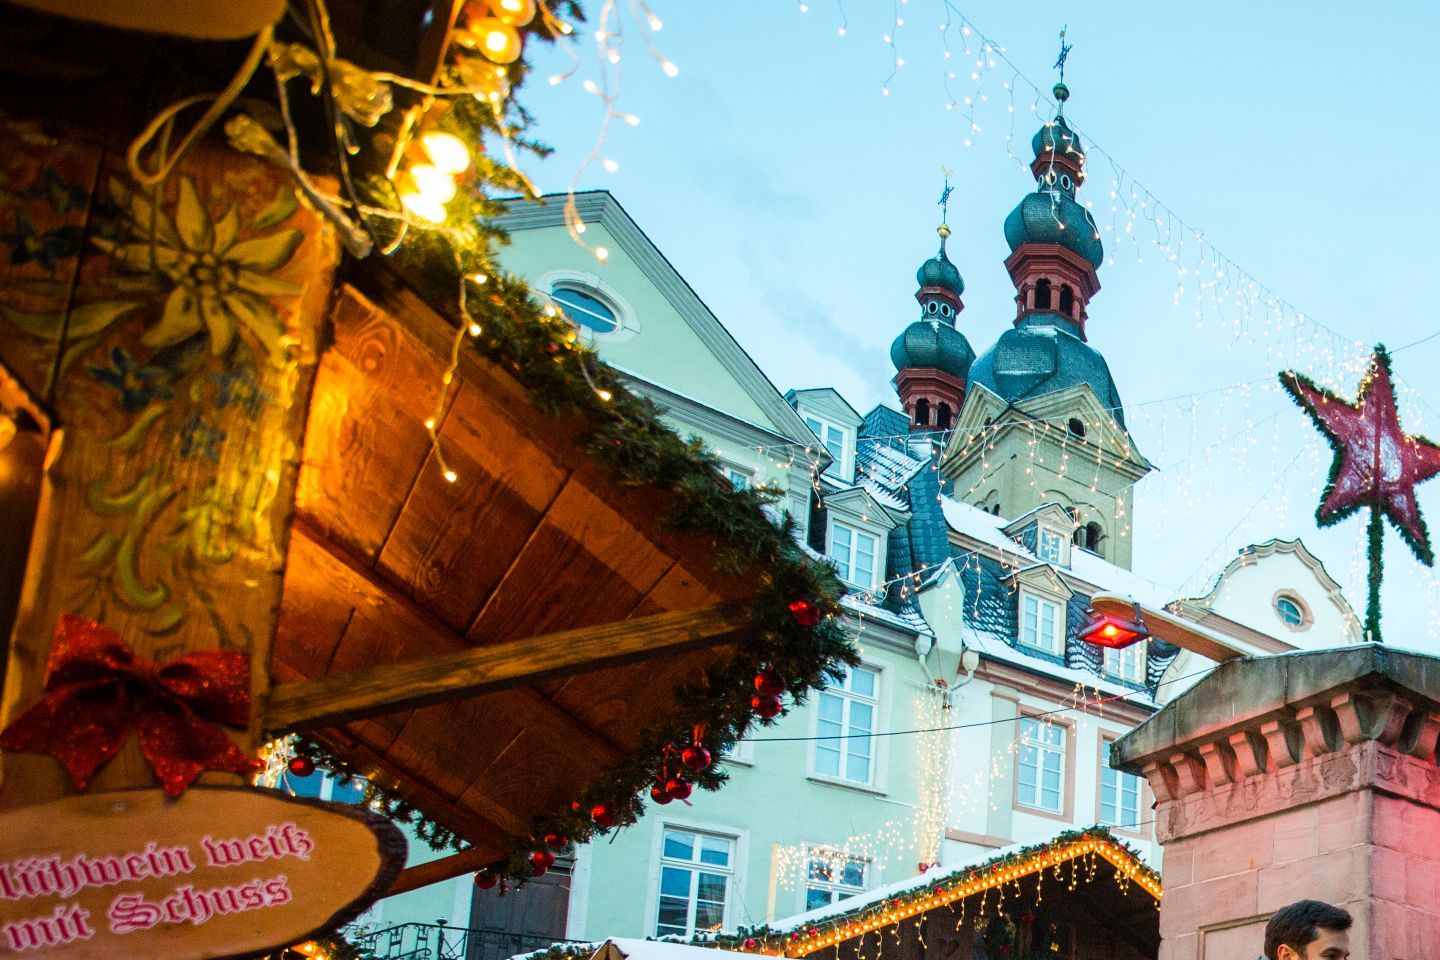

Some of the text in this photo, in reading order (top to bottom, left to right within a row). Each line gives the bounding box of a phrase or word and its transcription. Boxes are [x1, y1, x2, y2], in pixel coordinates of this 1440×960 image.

[0, 823, 313, 898] lühwein weiß
[4, 876, 291, 951] mit Schuss
